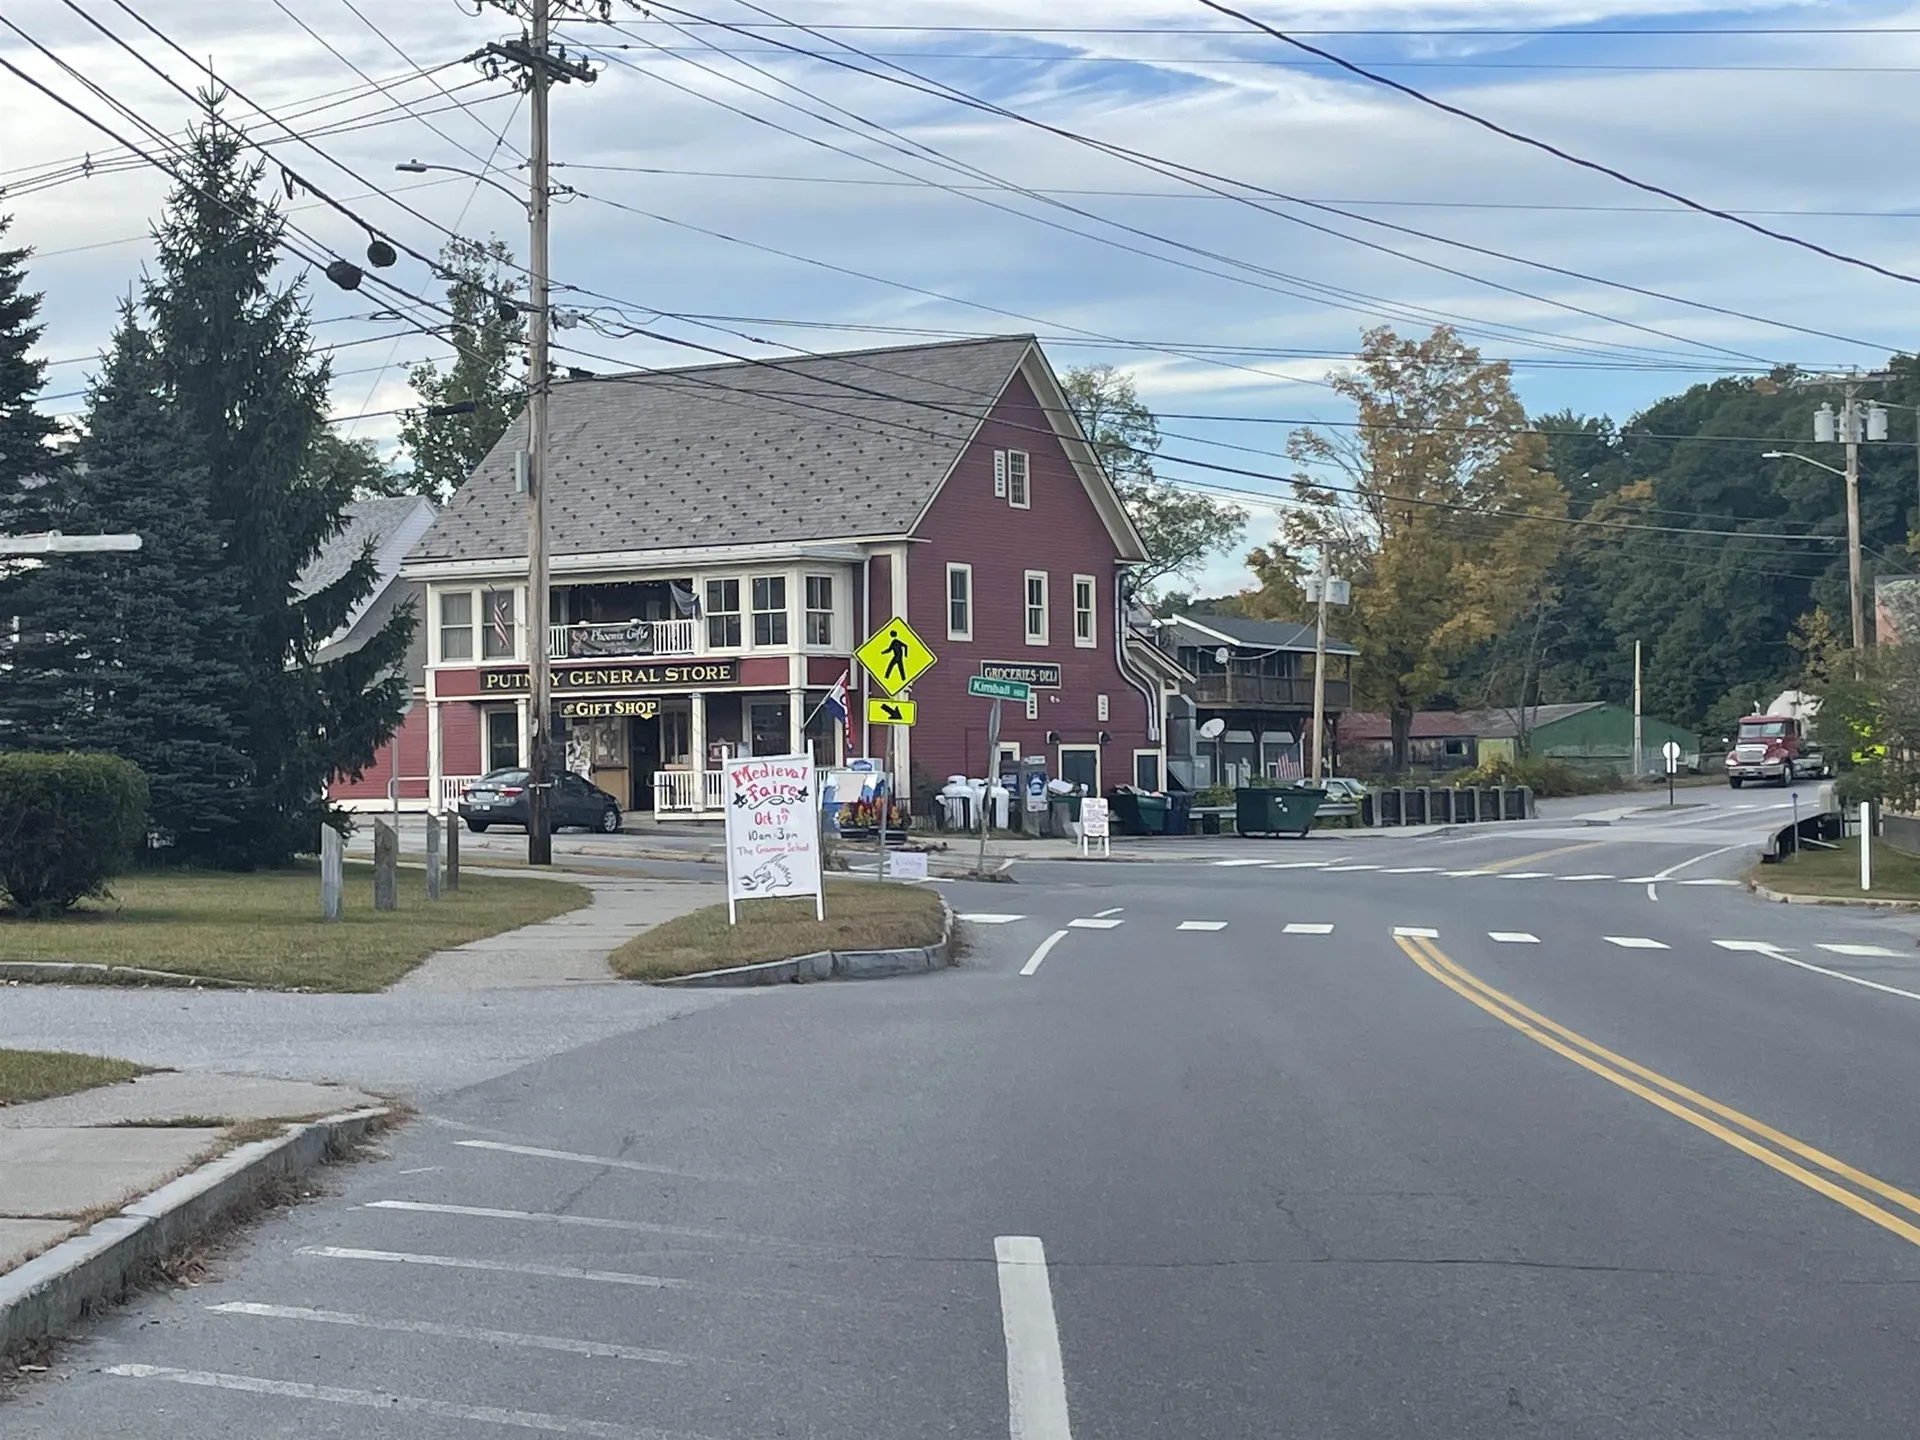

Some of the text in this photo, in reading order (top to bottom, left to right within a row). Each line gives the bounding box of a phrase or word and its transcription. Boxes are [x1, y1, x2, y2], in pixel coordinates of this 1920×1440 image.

[486, 666, 731, 689] PUTNY GENERAL STORE
[973, 681, 1011, 695] Kimball
[576, 701, 657, 716] GIFT SHOP
[731, 761, 808, 788] Medieval
[754, 811, 773, 825] Oct
[736, 845, 753, 856] The
